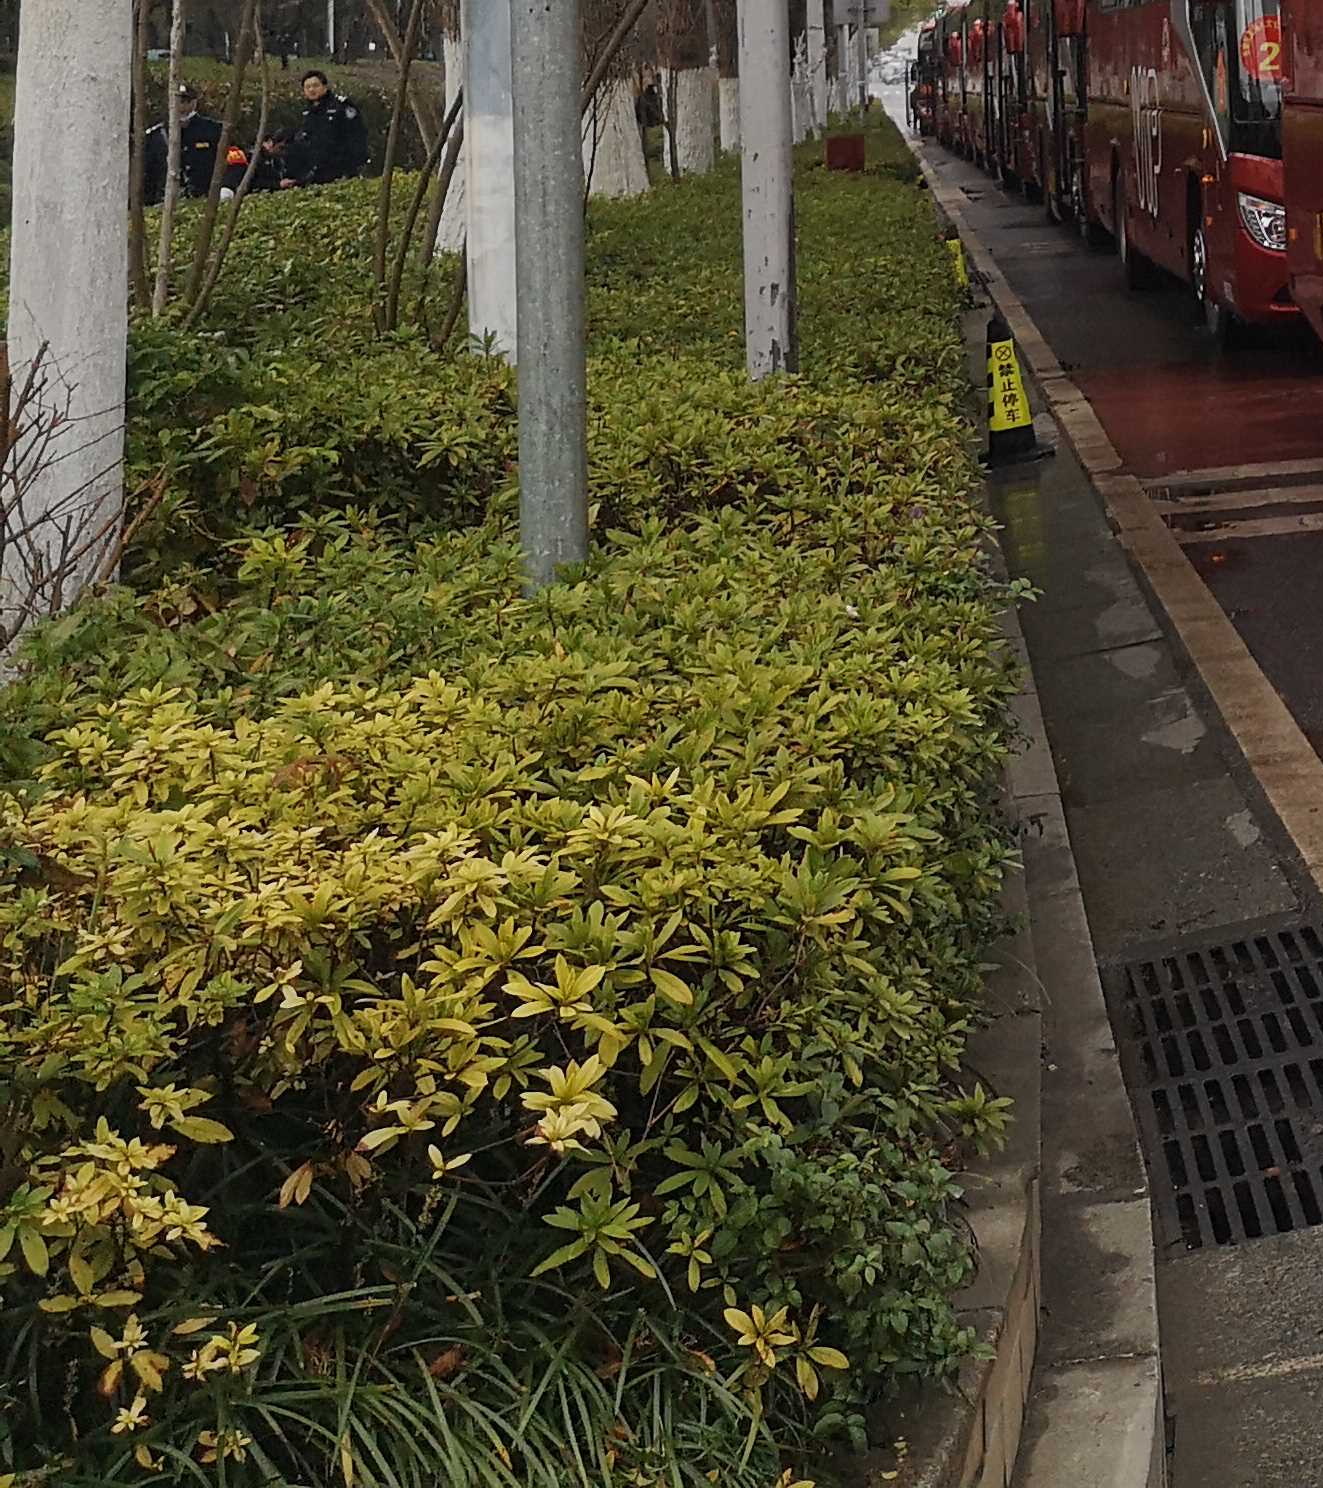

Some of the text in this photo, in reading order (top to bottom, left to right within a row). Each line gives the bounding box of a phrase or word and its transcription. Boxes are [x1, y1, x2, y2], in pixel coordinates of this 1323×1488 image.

[1259, 42, 1280, 71] 2
[998, 363, 1022, 423] 禁止停车
